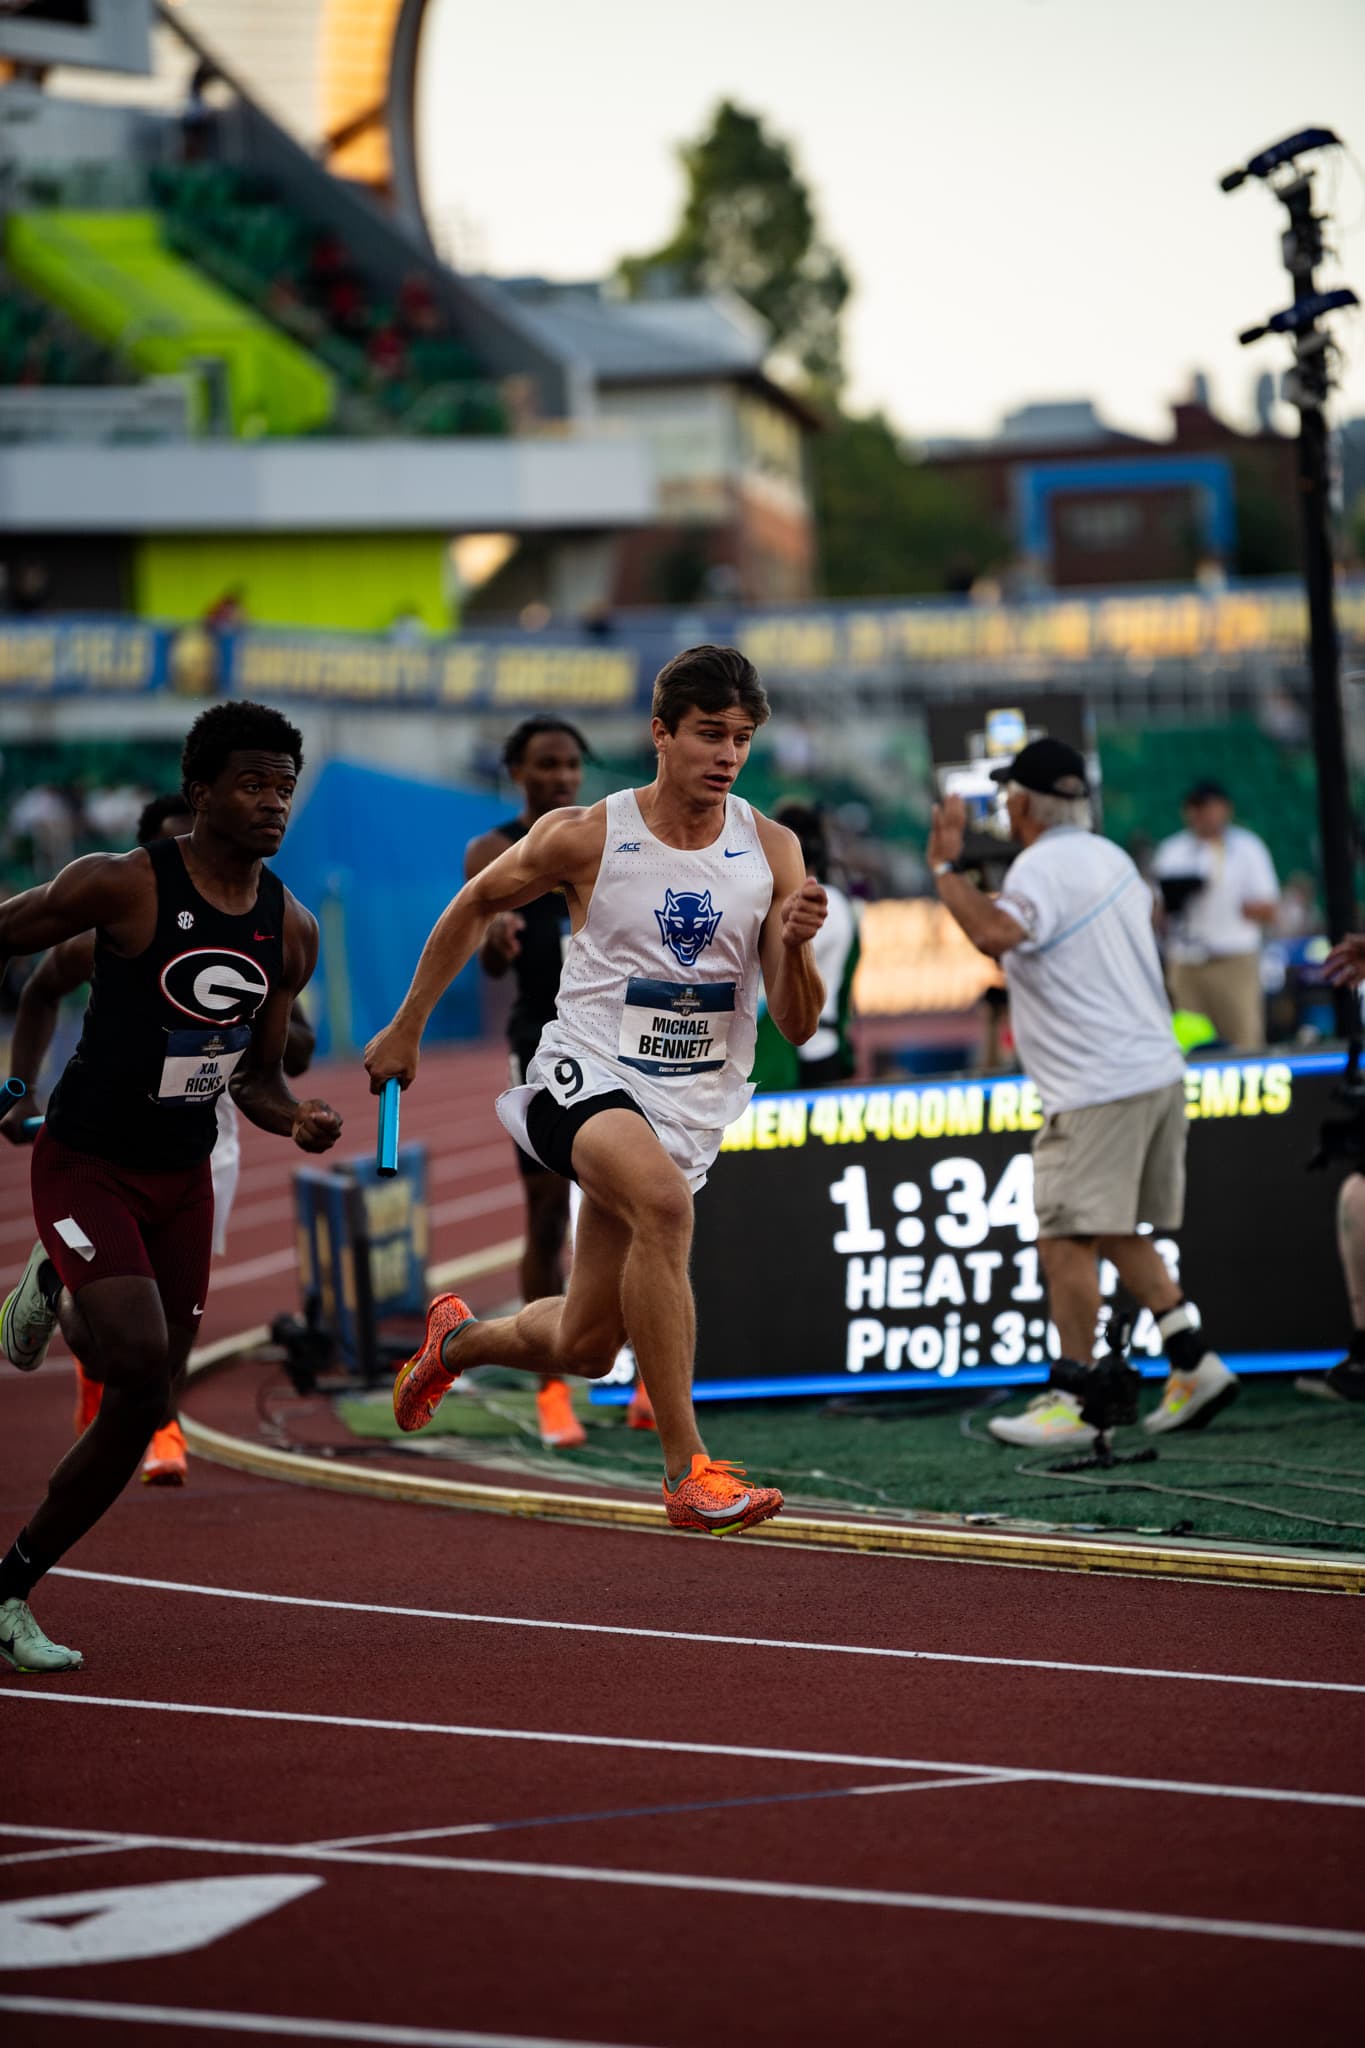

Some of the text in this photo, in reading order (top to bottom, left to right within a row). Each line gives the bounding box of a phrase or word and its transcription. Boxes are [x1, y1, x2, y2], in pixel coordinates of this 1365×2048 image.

[615, 842, 641, 853] ACC
[177, 911, 195, 930] SEC
[651, 1015, 710, 1036] MICHAEL
[638, 1034, 714, 1060] BENNETT
[199, 1062, 219, 1075] XAI
[553, 1057, 584, 1099] 9
[184, 1075, 223, 1093] RICKS
[809, 1083, 985, 1146] 4X400M
[1183, 1063, 1292, 1120] EMIS
[829, 1153, 1040, 1253] 1:34
[846, 1250, 1003, 1311] HEAT
[1011, 1246, 1044, 1302] 1
[846, 1311, 982, 1378] Proj:
